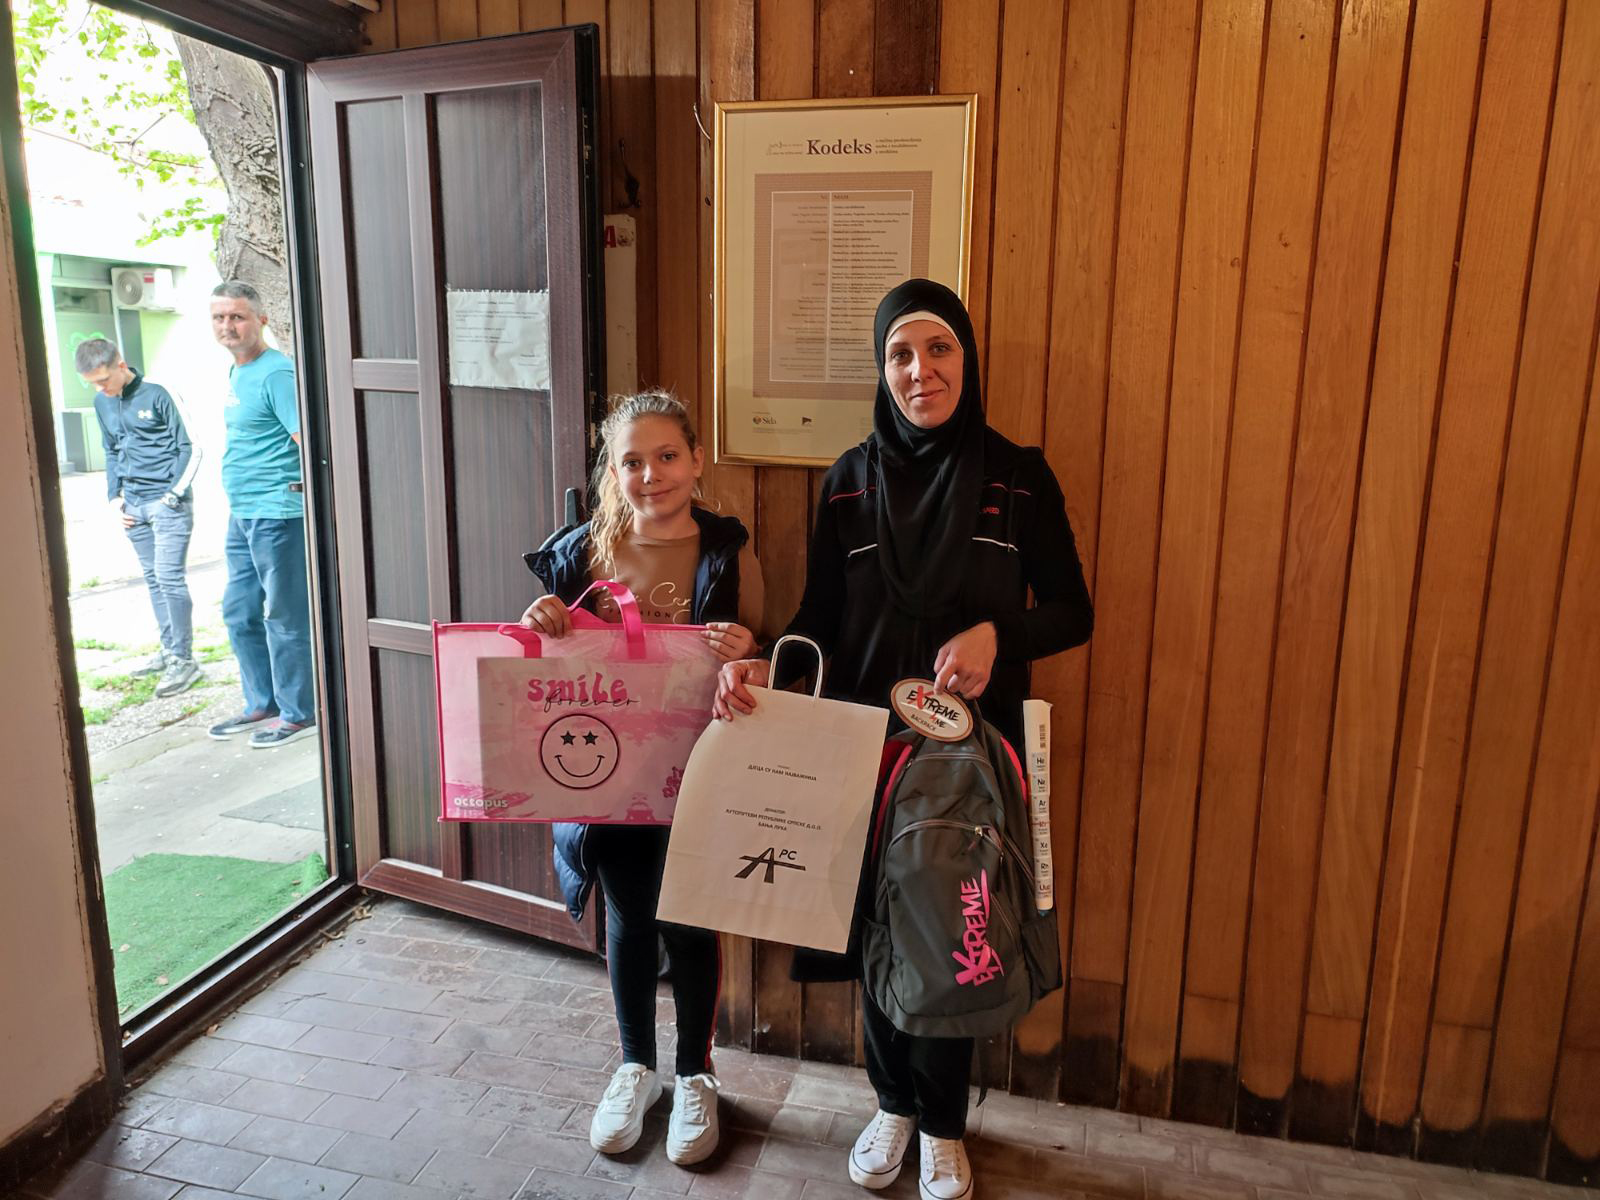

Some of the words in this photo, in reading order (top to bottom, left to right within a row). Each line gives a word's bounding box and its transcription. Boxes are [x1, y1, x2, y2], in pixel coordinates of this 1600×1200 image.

[806, 138, 872, 155] Kodeks
[527, 672, 628, 702] smile
[543, 688, 641, 713] forever
[906, 685, 960, 721] EXTREME
[453, 797, 509, 811] octopus
[952, 875, 1004, 986] EXTREME
